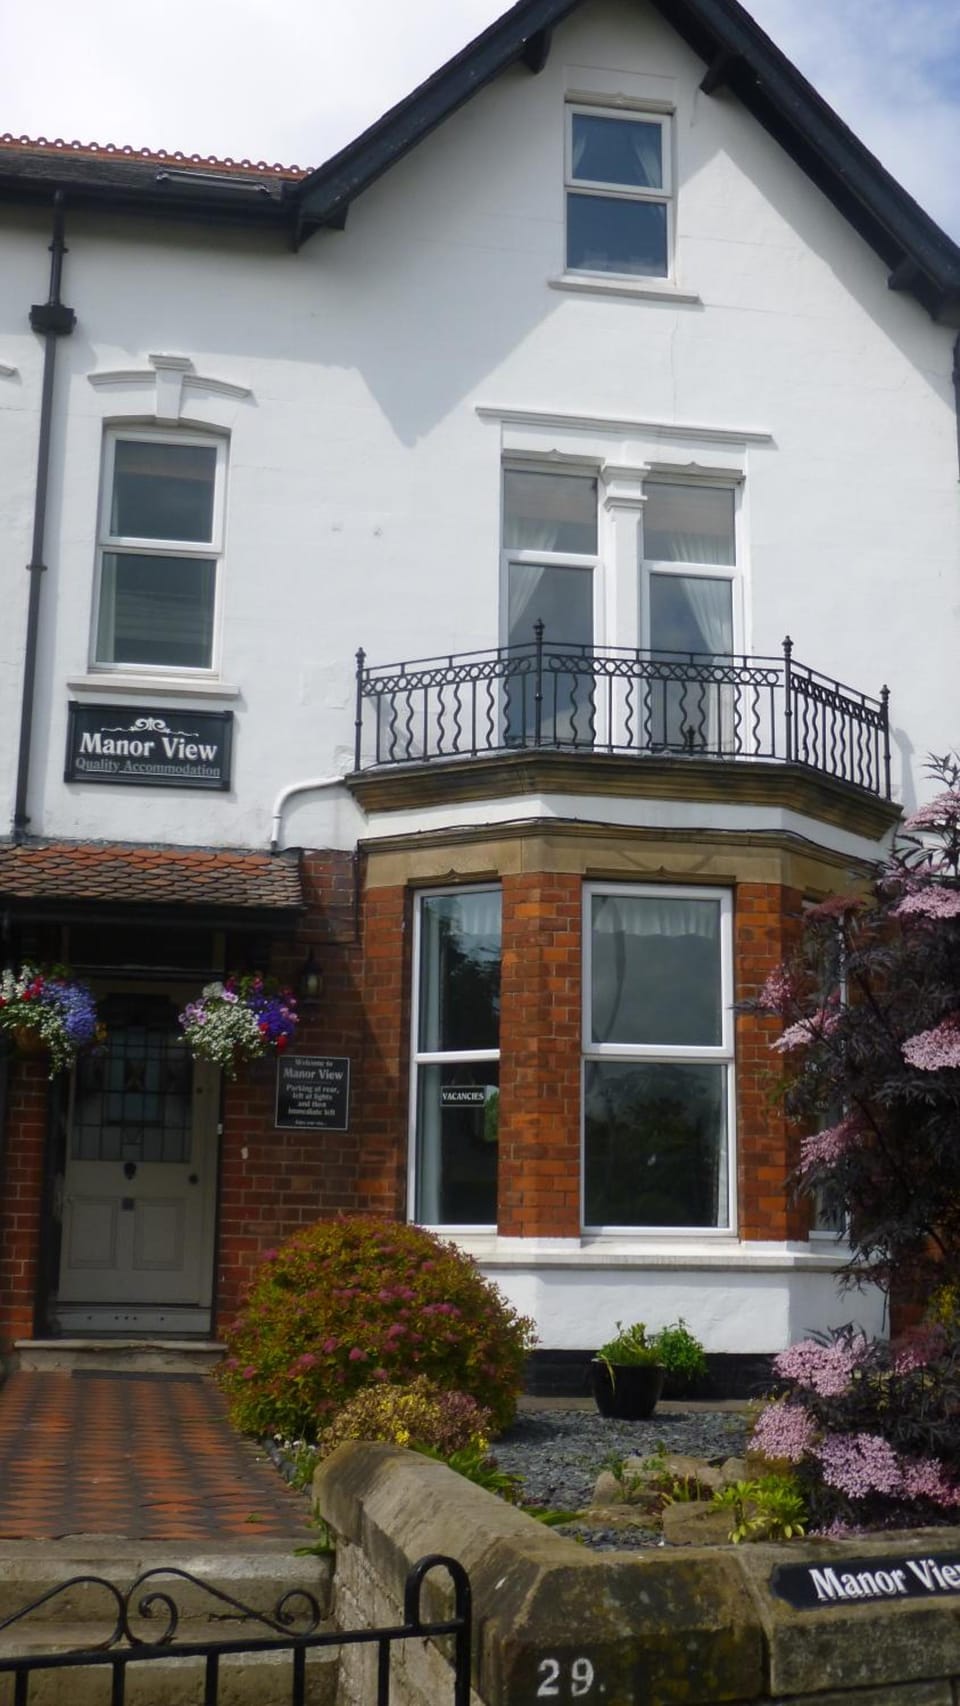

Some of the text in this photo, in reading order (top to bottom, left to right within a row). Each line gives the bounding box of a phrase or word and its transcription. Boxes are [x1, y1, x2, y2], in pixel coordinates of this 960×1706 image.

[79, 732, 217, 761] Manor View
[75, 757, 221, 776] Quality Accommodation
[283, 1068, 344, 1080] Manor View
[286, 1084, 313, 1093] Parking
[442, 1092, 485, 1101] VACANCIES
[808, 1558, 960, 1601] Manor Vie
